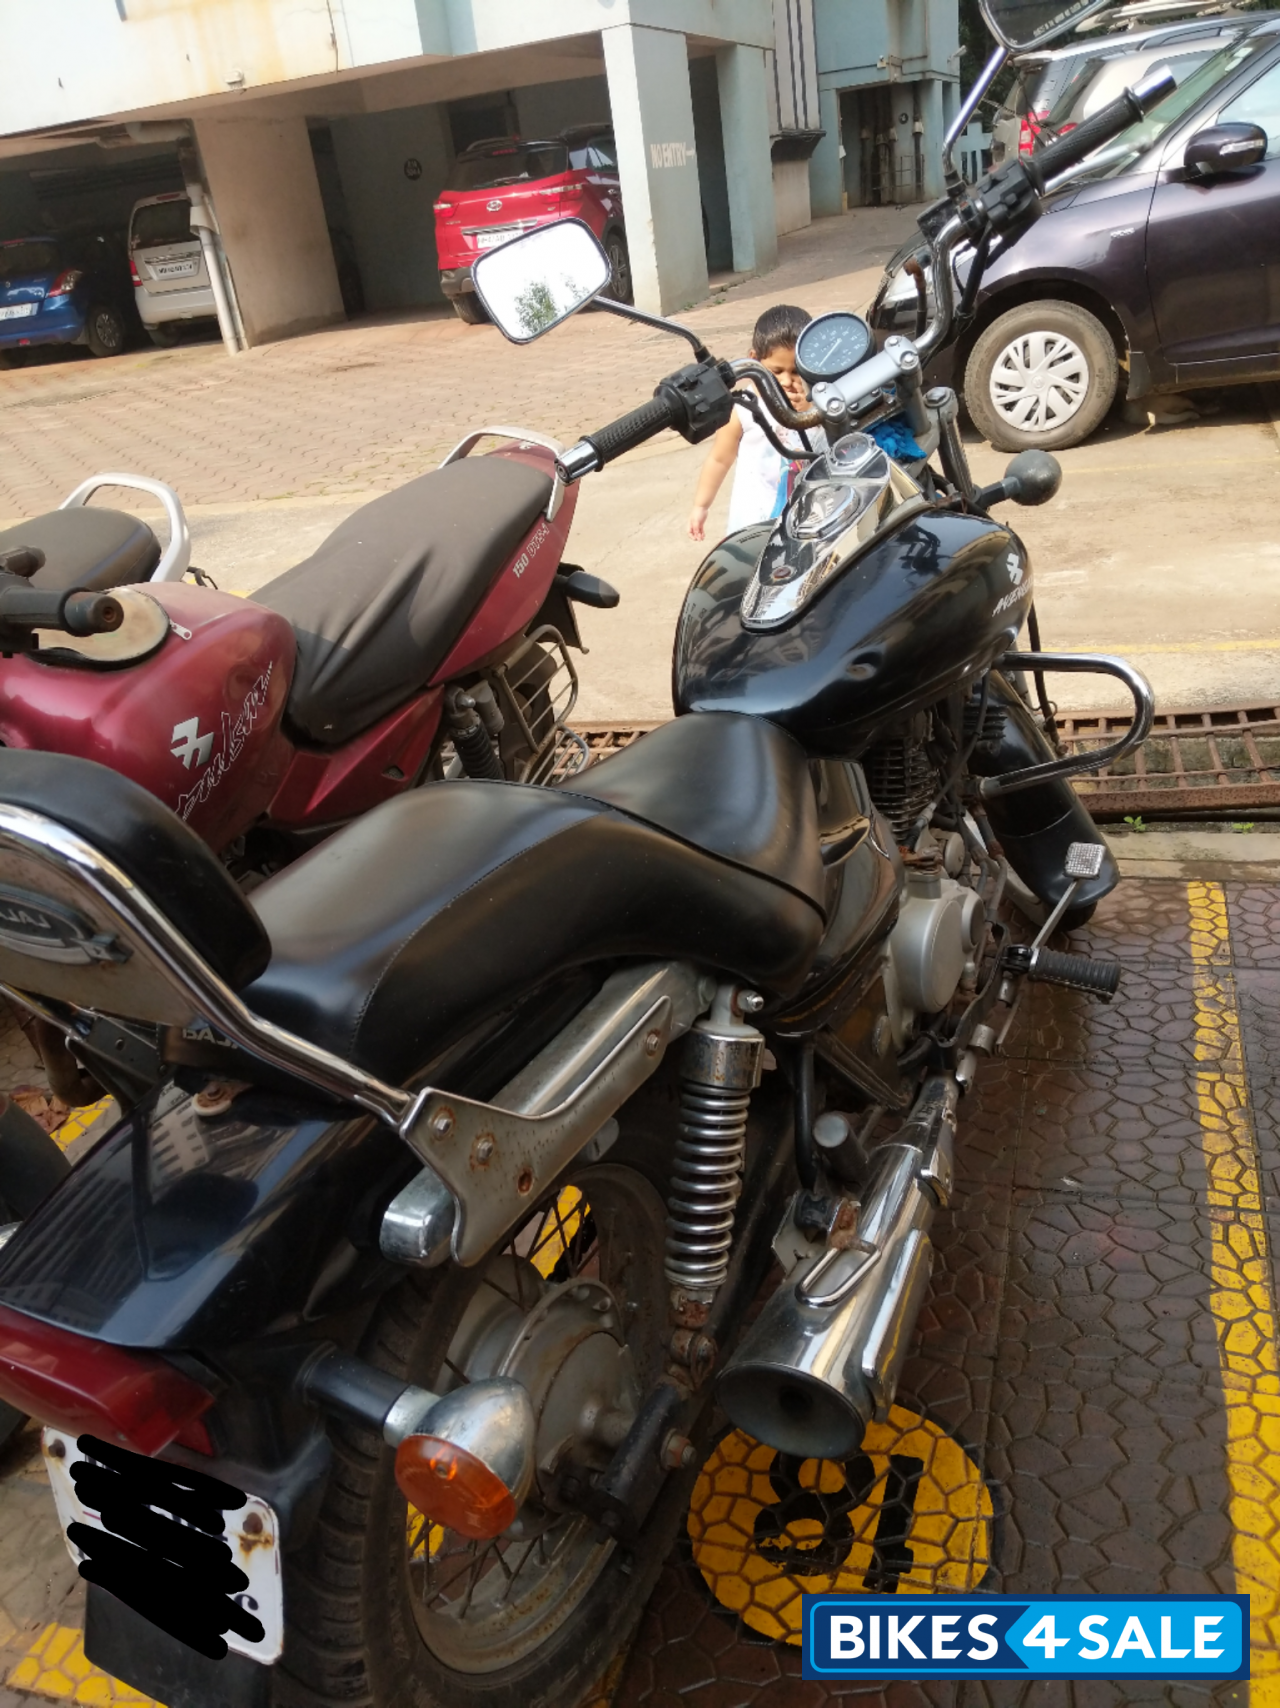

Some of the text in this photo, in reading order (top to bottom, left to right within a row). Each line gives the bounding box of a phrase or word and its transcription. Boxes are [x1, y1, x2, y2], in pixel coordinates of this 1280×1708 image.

[650, 141, 687, 169] NO ENTRY
[512, 552, 530, 579] 150
